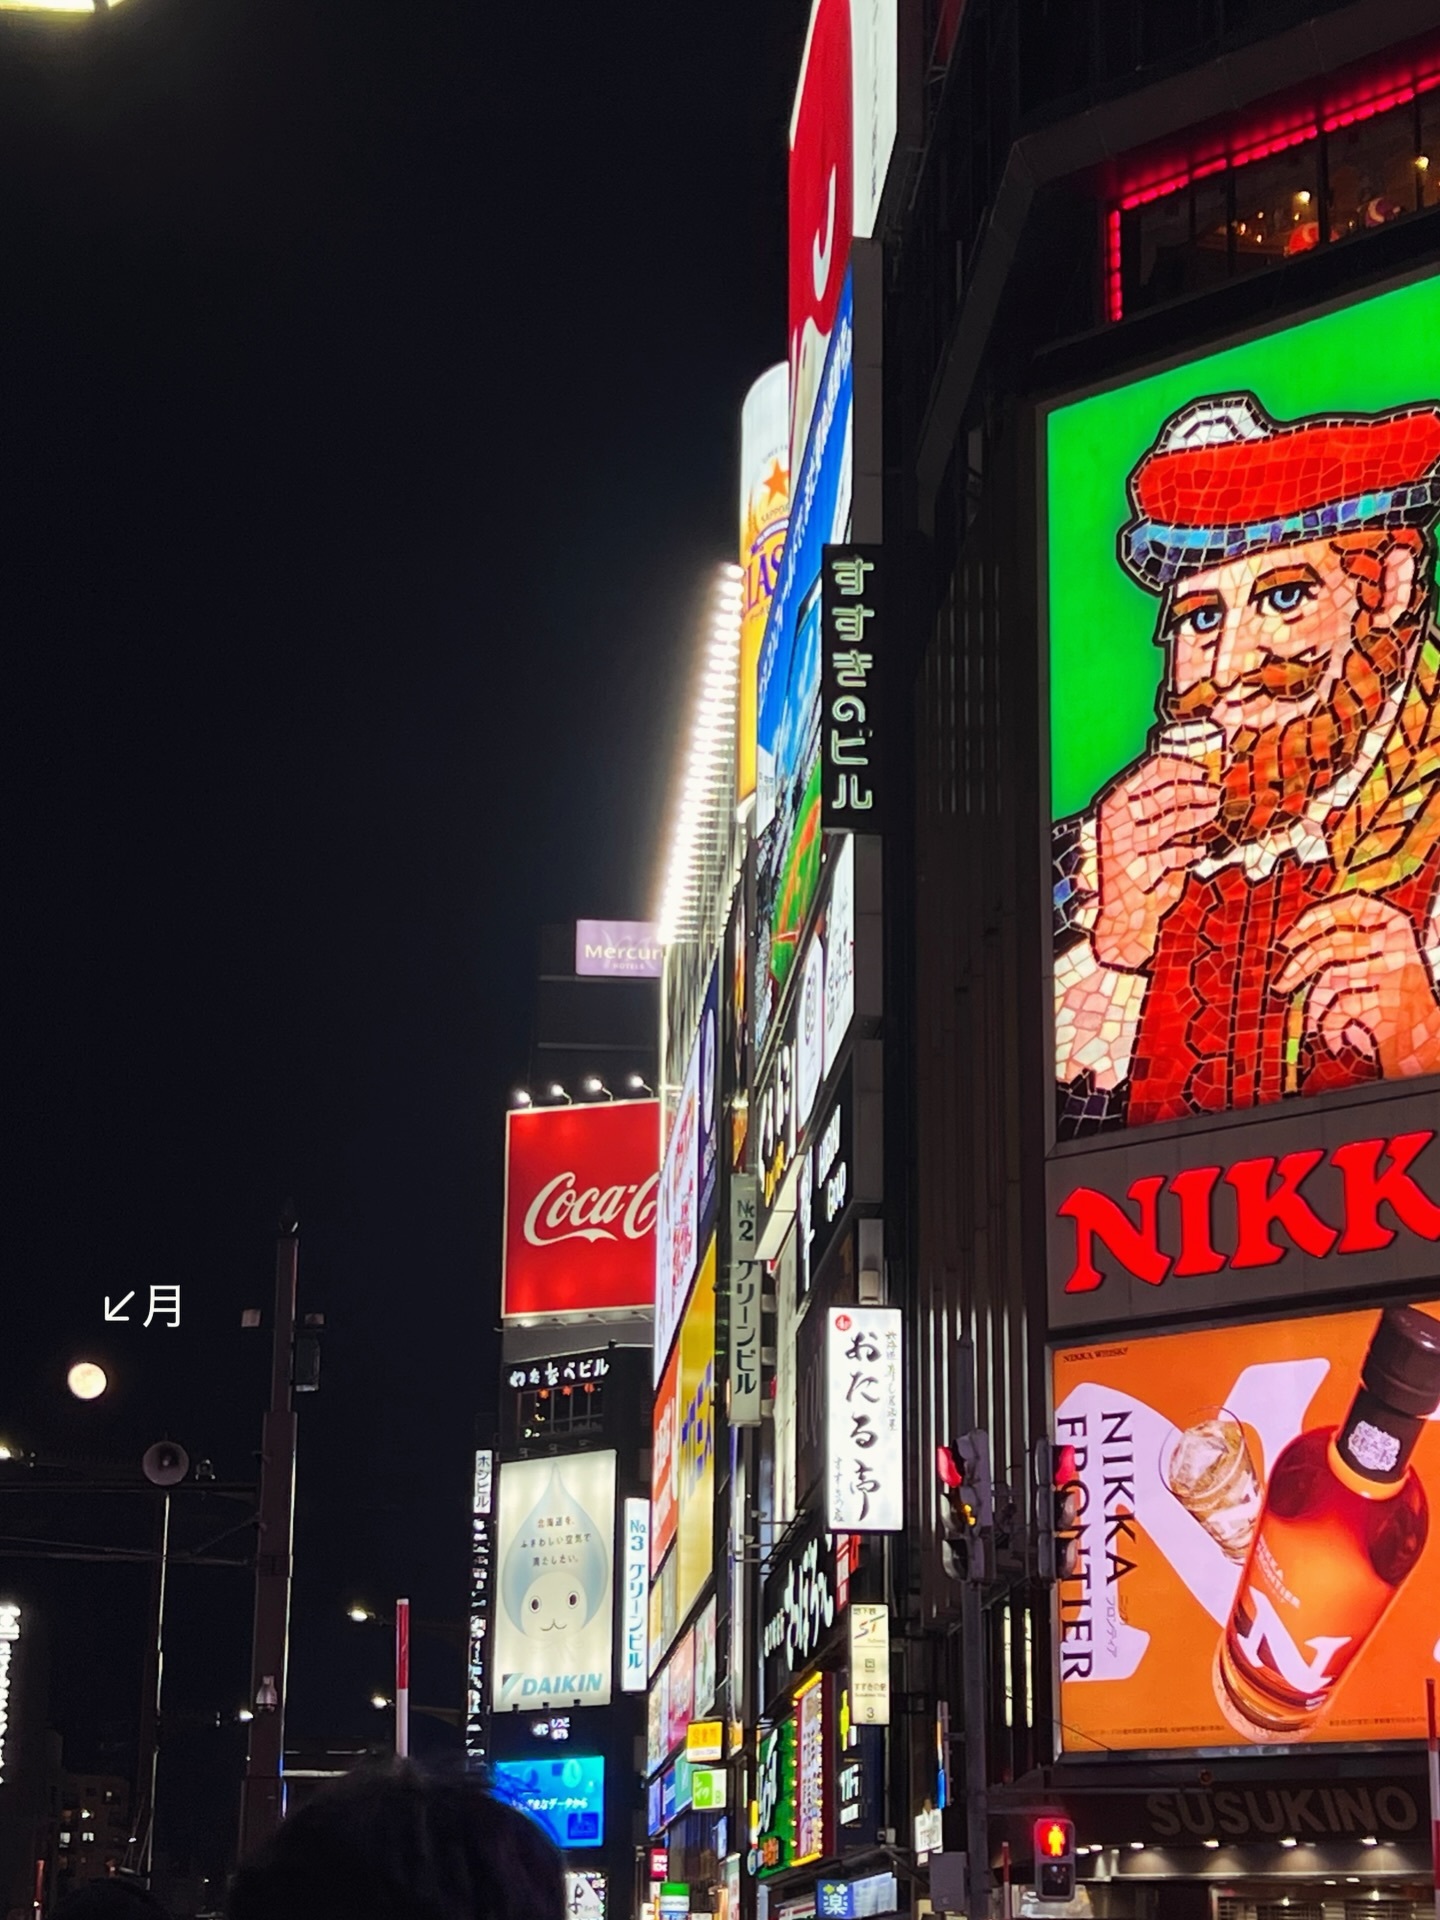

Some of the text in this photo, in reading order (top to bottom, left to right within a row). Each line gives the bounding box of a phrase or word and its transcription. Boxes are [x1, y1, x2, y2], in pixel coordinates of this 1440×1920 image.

[831, 557, 875, 810] すすきのビル
[1057, 1129, 1440, 1294] NIKK
[1101, 1410, 1138, 1586] NIKKA
[1106, 1597, 1118, 1658] フロンティア
[521, 1673, 603, 1697] DAIKIN
[866, 1707, 875, 1719] 3
[1147, 1786, 1418, 1836] SUSUKINO
